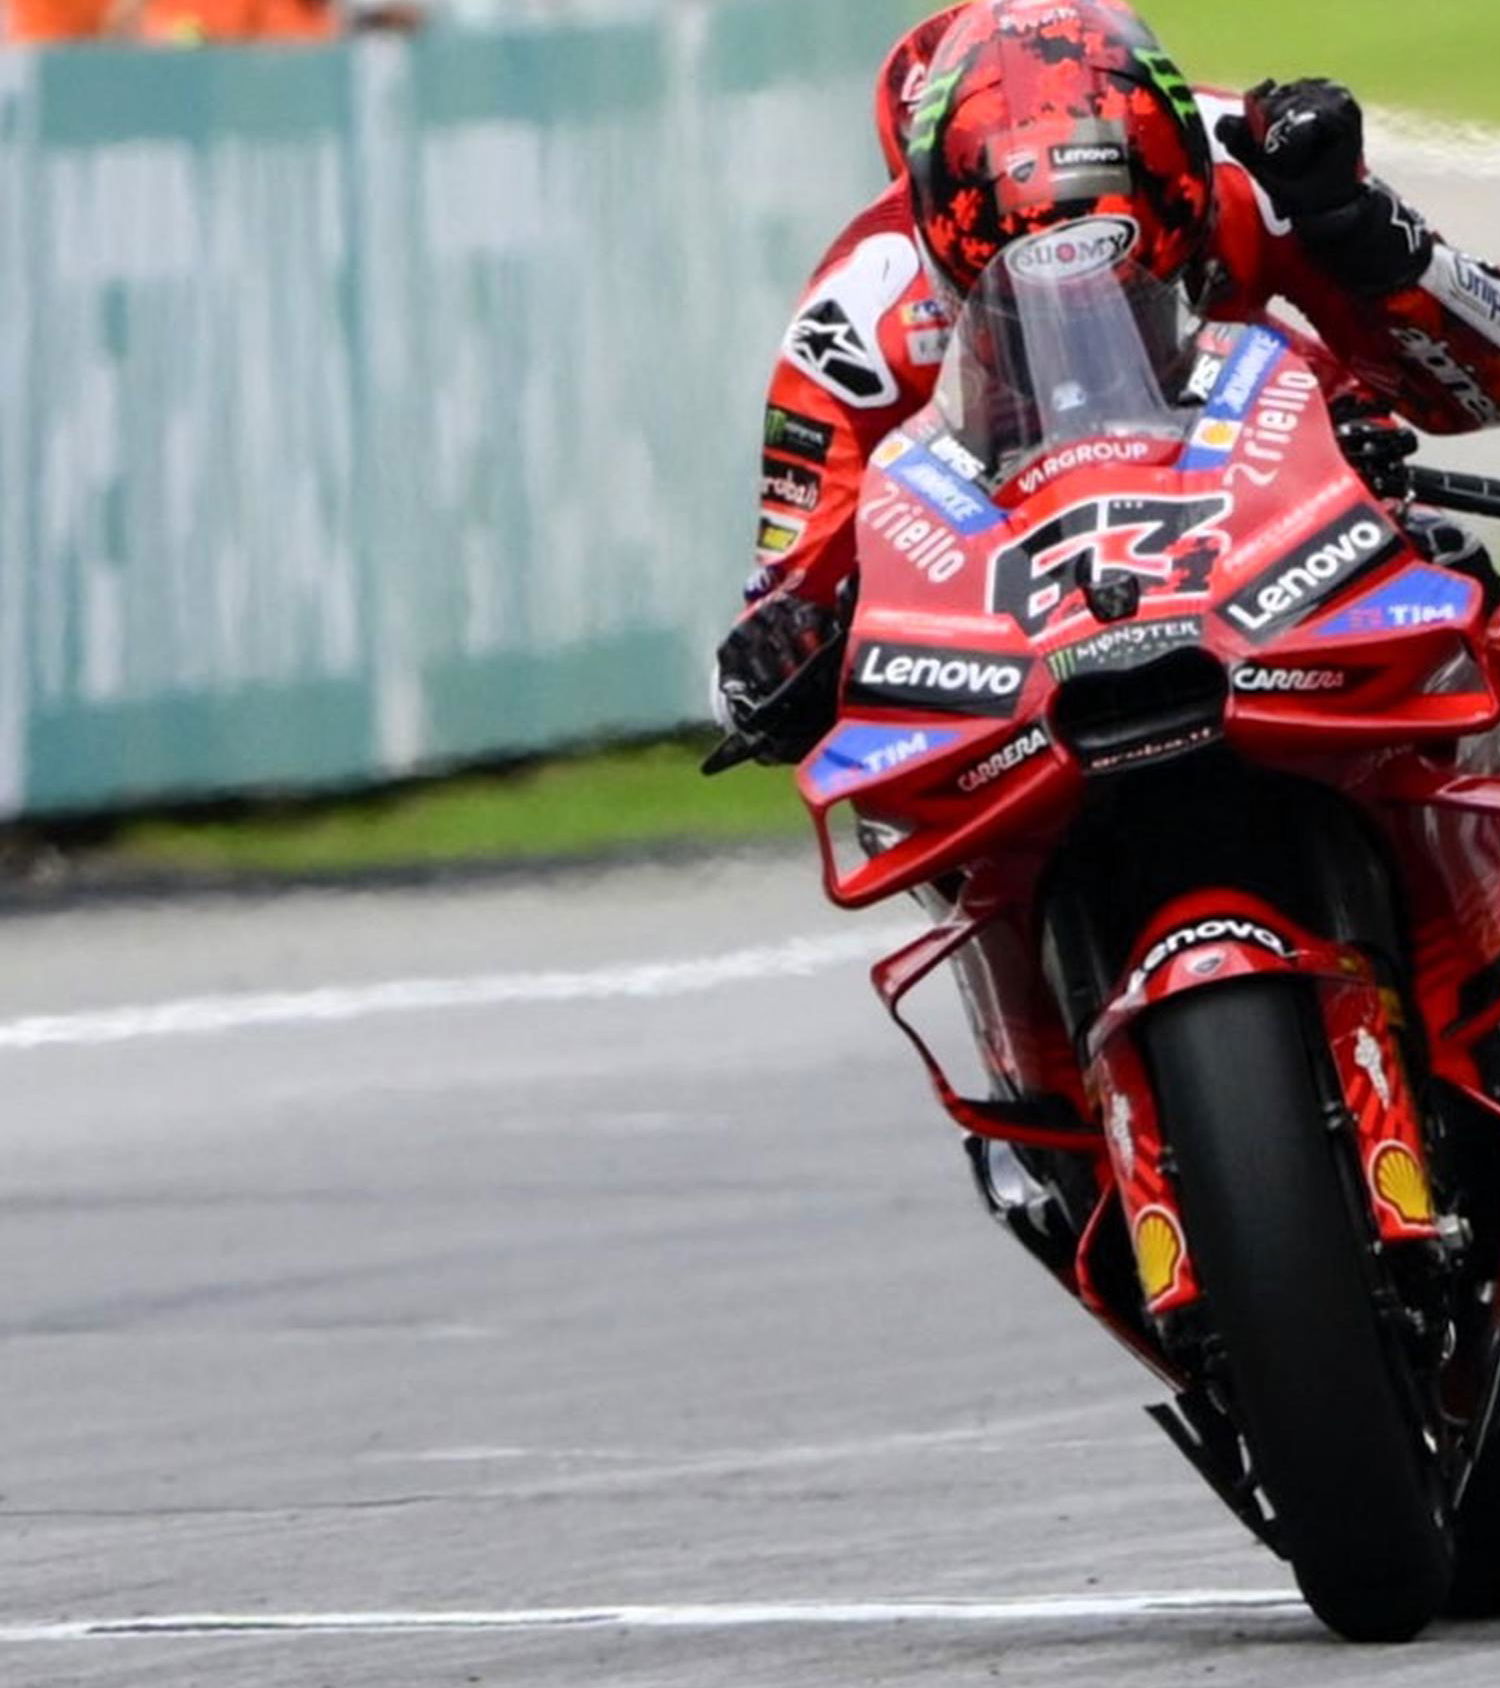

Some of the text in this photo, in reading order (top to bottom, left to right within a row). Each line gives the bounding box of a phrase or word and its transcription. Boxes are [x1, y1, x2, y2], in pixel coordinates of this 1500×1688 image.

[1052, 147, 1119, 165] Lenovo
[1227, 520, 1382, 631] Lenovo
[1388, 604, 1456, 625] TIM
[1075, 620, 1200, 662] MONSTER
[860, 646, 1021, 695] Lenovo
[1233, 667, 1345, 691] CARRERA
[861, 731, 929, 774] TIM
[956, 727, 1047, 793] CARRERA
